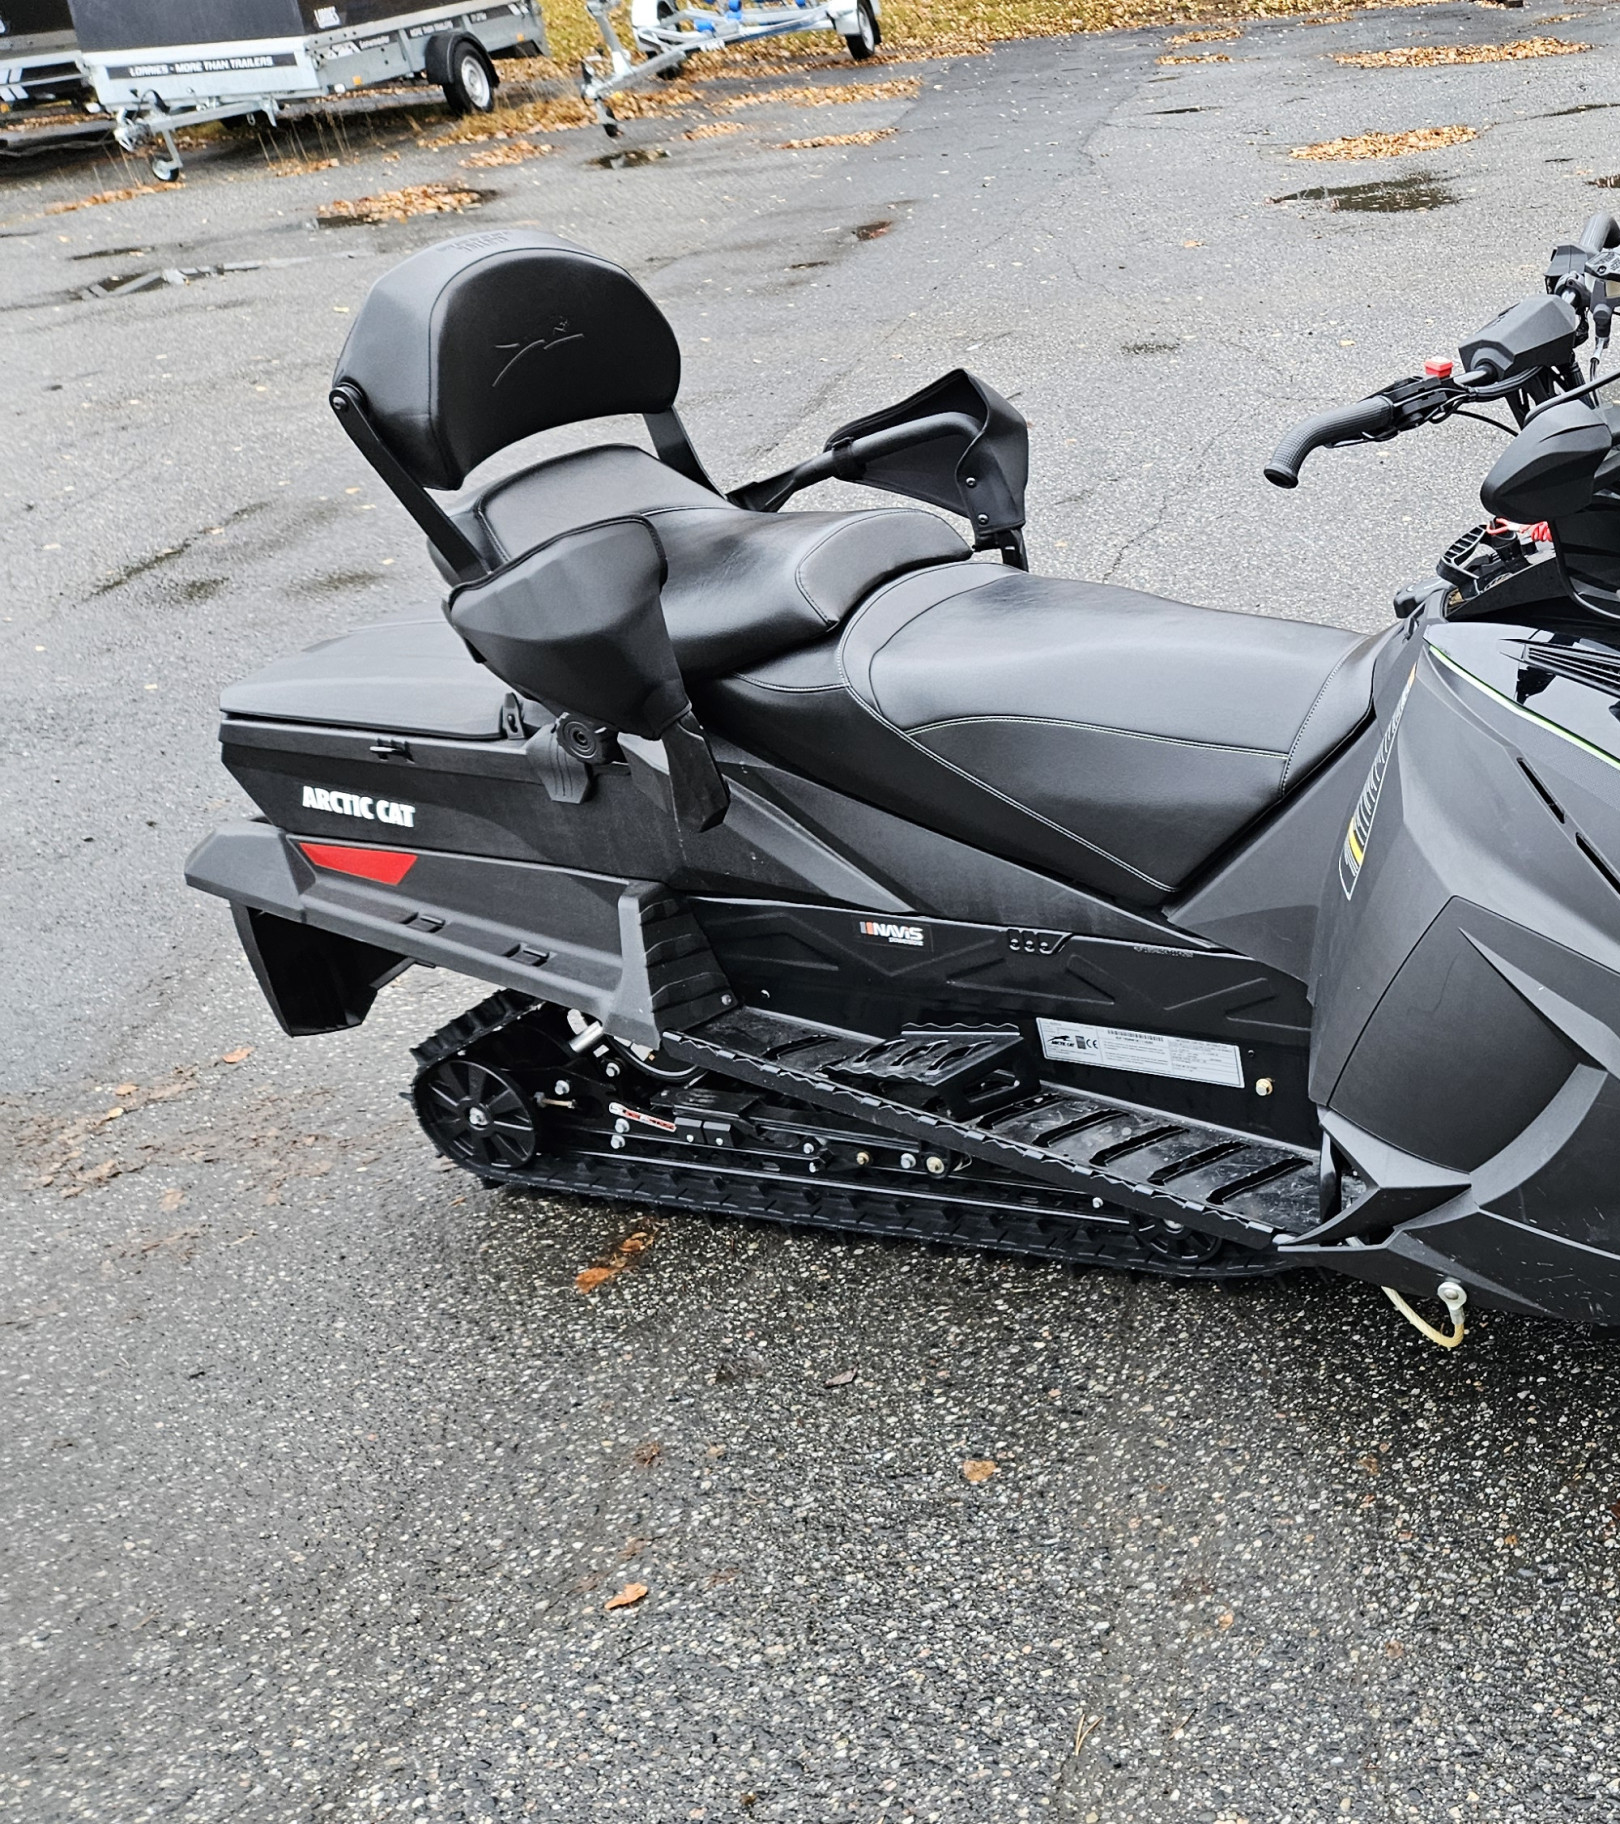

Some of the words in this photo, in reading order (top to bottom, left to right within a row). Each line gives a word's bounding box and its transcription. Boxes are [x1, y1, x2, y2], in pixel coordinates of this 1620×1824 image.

[174, 61, 203, 75] MORE
[203, 58, 230, 71] THAN
[230, 56, 274, 70] TRAILERS
[302, 785, 375, 820] ARCTIC
[376, 799, 416, 828] CAT
